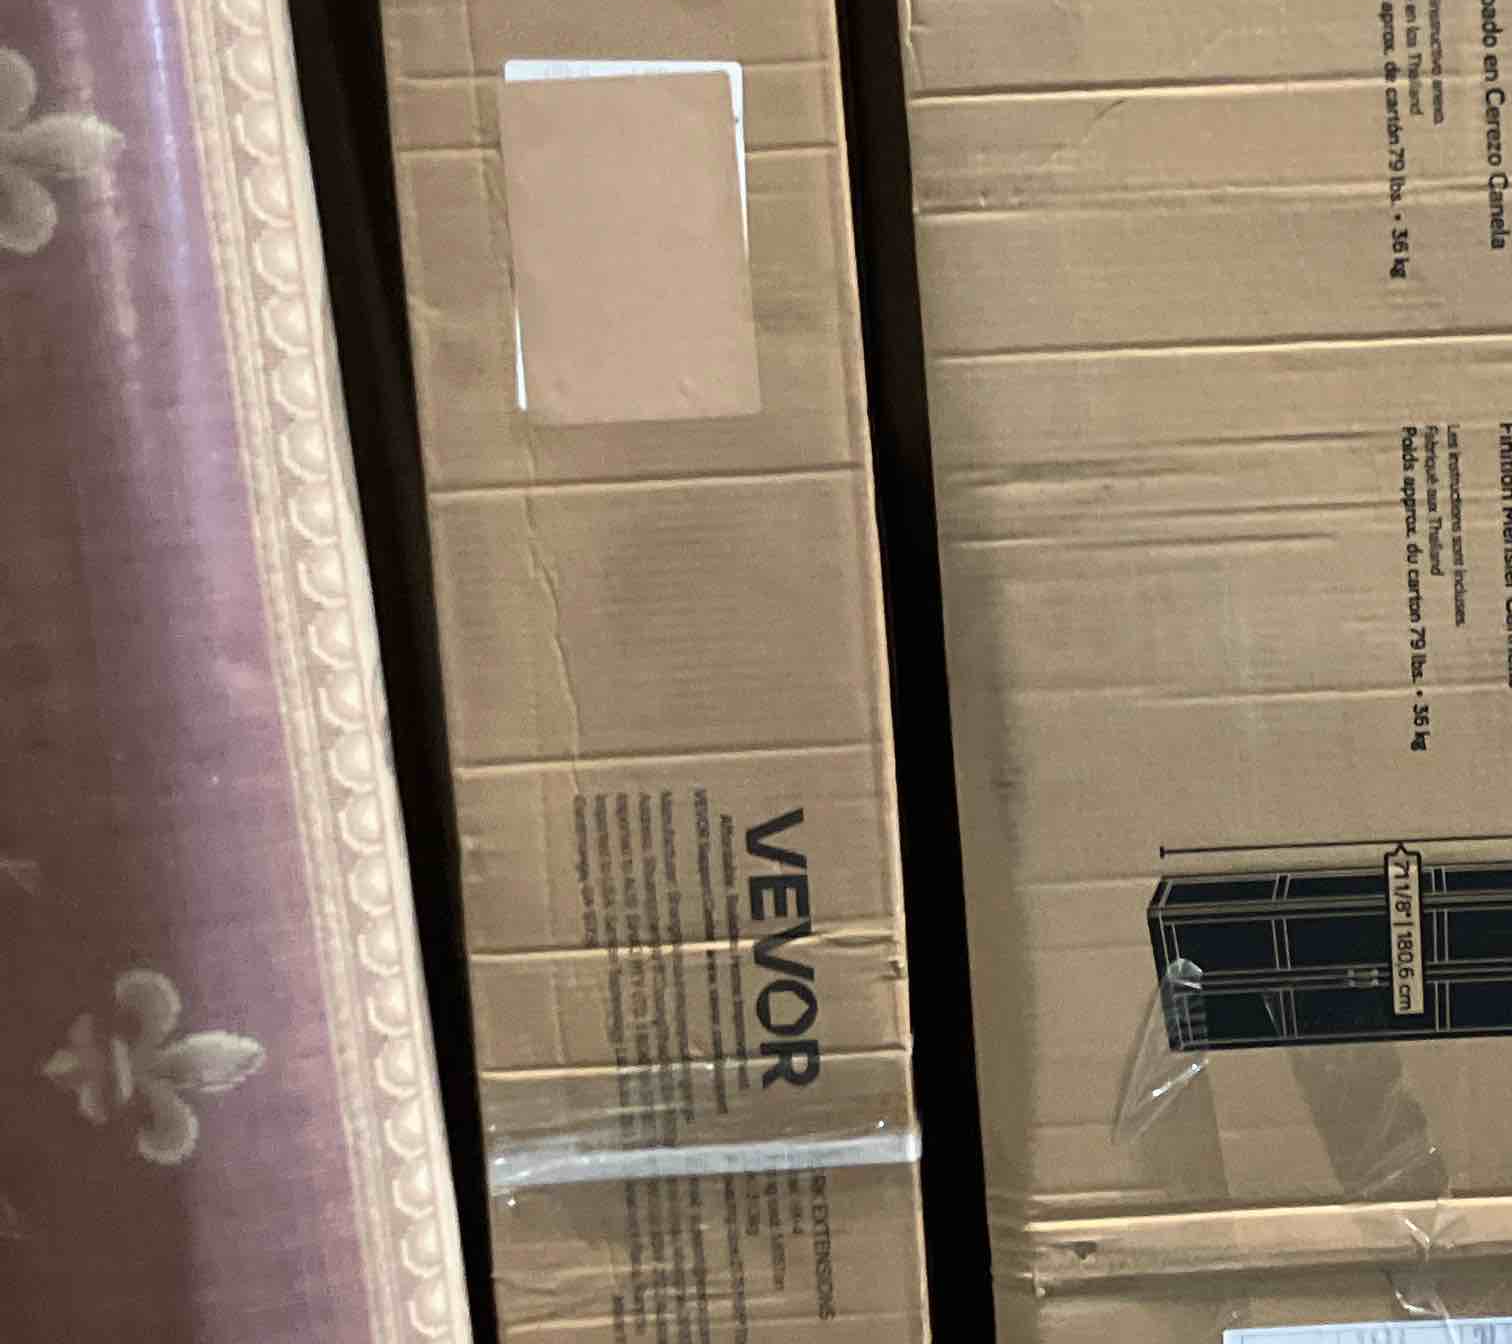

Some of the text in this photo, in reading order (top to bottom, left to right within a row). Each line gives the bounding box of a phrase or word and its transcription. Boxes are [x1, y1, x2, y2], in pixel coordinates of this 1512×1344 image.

[1404, 4, 1417, 23] en
[1378, 1, 1396, 56] aprox.
[1384, 61, 1402, 82] de
[1483, 55, 1500, 82] en
[1385, 87, 1403, 145] cartón
[1484, 87, 1505, 167] Cerezo
[1388, 147, 1406, 172] 79
[1488, 173, 1510, 250] Canela
[1389, 257, 1411, 279] kg
[1401, 426, 1419, 472] Poids
[1405, 543, 1424, 564] du
[1406, 568, 1423, 623] carton
[1408, 626, 1427, 651] 79
[1410, 653, 1428, 684] lbs.
[1412, 703, 1430, 727] 36
[1410, 731, 1432, 752] kg
[1394, 860, 1411, 880] 71
[745, 807, 822, 1089] VEVOR
[1398, 984, 1412, 1011] cm
[812, 1204, 837, 1321] EXTENSIONS
